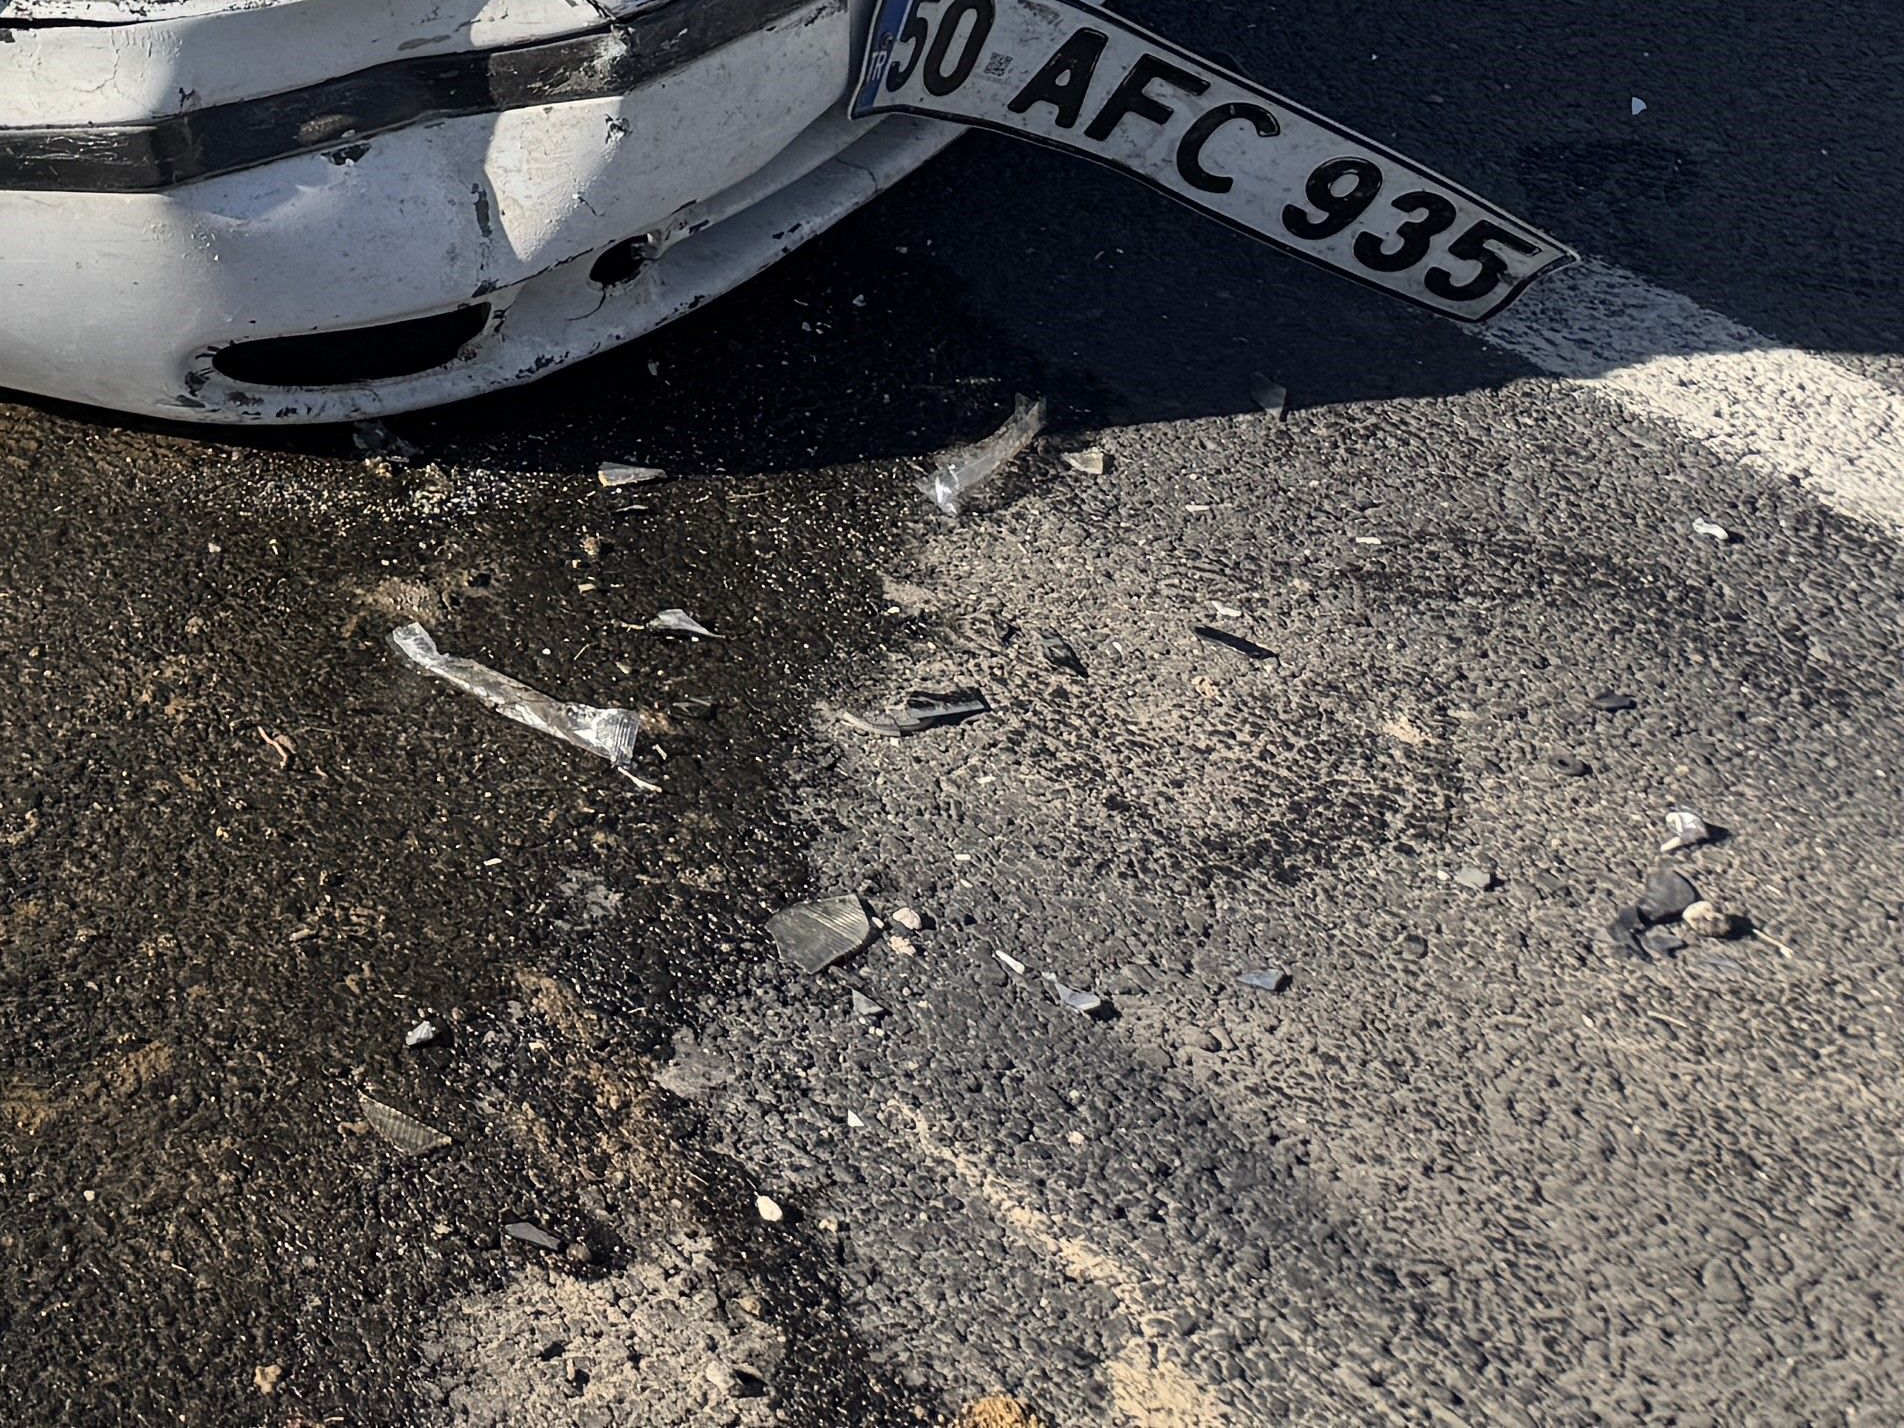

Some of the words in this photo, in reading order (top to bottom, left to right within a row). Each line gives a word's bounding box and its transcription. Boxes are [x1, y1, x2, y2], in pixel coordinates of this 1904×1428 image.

[866, 50, 888, 84] TR
[1006, 26, 1281, 195] AFC
[1281, 156, 1544, 302] 935
